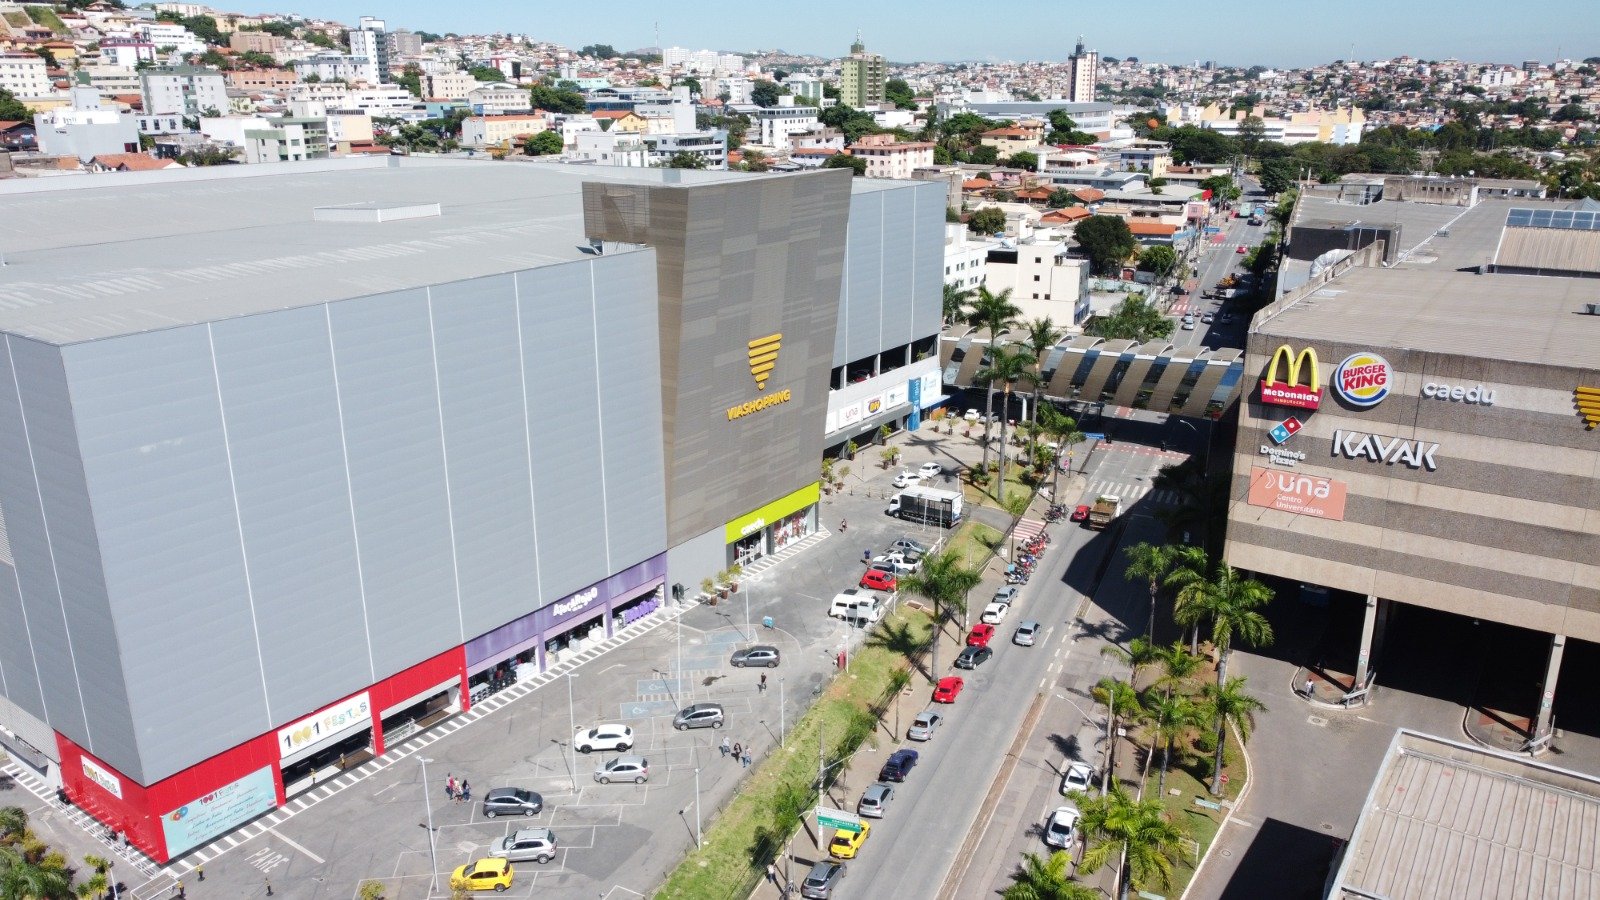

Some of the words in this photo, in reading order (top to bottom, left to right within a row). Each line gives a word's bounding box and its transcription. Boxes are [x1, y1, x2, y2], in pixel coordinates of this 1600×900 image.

[1343, 364, 1386, 378] BURGER
[1343, 373, 1387, 392] KING
[1263, 388, 1319, 402] McDonald's
[1422, 382, 1497, 405] caedu
[727, 389, 790, 421] VIASHOPPING
[1260, 445, 1306, 460] Domino's
[1333, 429, 1441, 470] KAVAK
[1270, 455, 1297, 466] Pizza
[1278, 474, 1330, 499] una
[1276, 493, 1302, 504] Centro
[1276, 501, 1324, 515] Universitário
[284, 721, 320, 748] 1001
[324, 701, 368, 731] FESTAS
[244, 847, 290, 873] PARE
